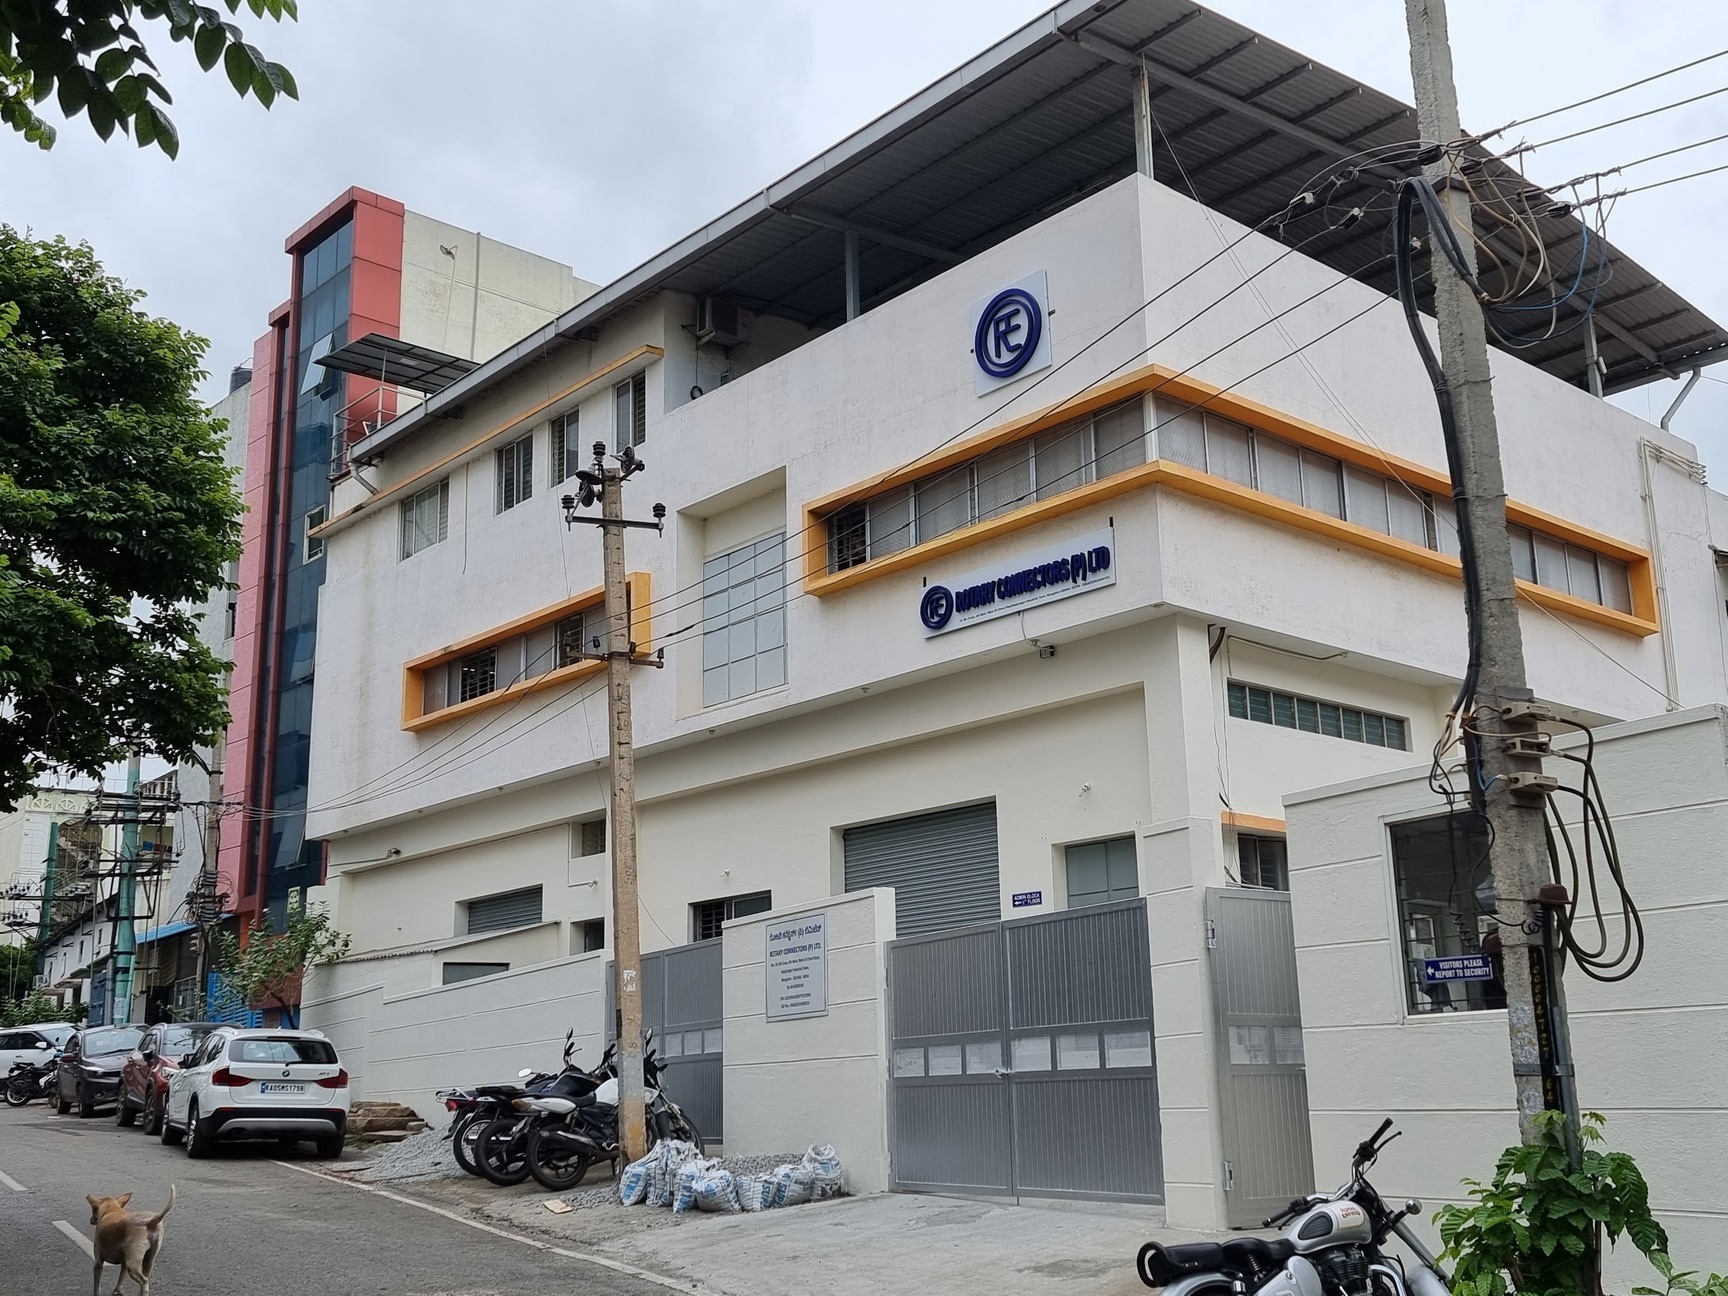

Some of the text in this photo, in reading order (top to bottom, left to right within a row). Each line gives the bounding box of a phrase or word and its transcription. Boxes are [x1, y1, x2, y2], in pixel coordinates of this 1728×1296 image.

[955, 580, 996, 613] ROTARY
[996, 557, 1071, 600] CONNECTORS
[1070, 552, 1087, 584] (P)
[1087, 545, 1110, 574] LTD
[1438, 958, 1484, 970] VISITORS PLEASE
[1435, 968, 1490, 978] REPORT TO SECURITY
